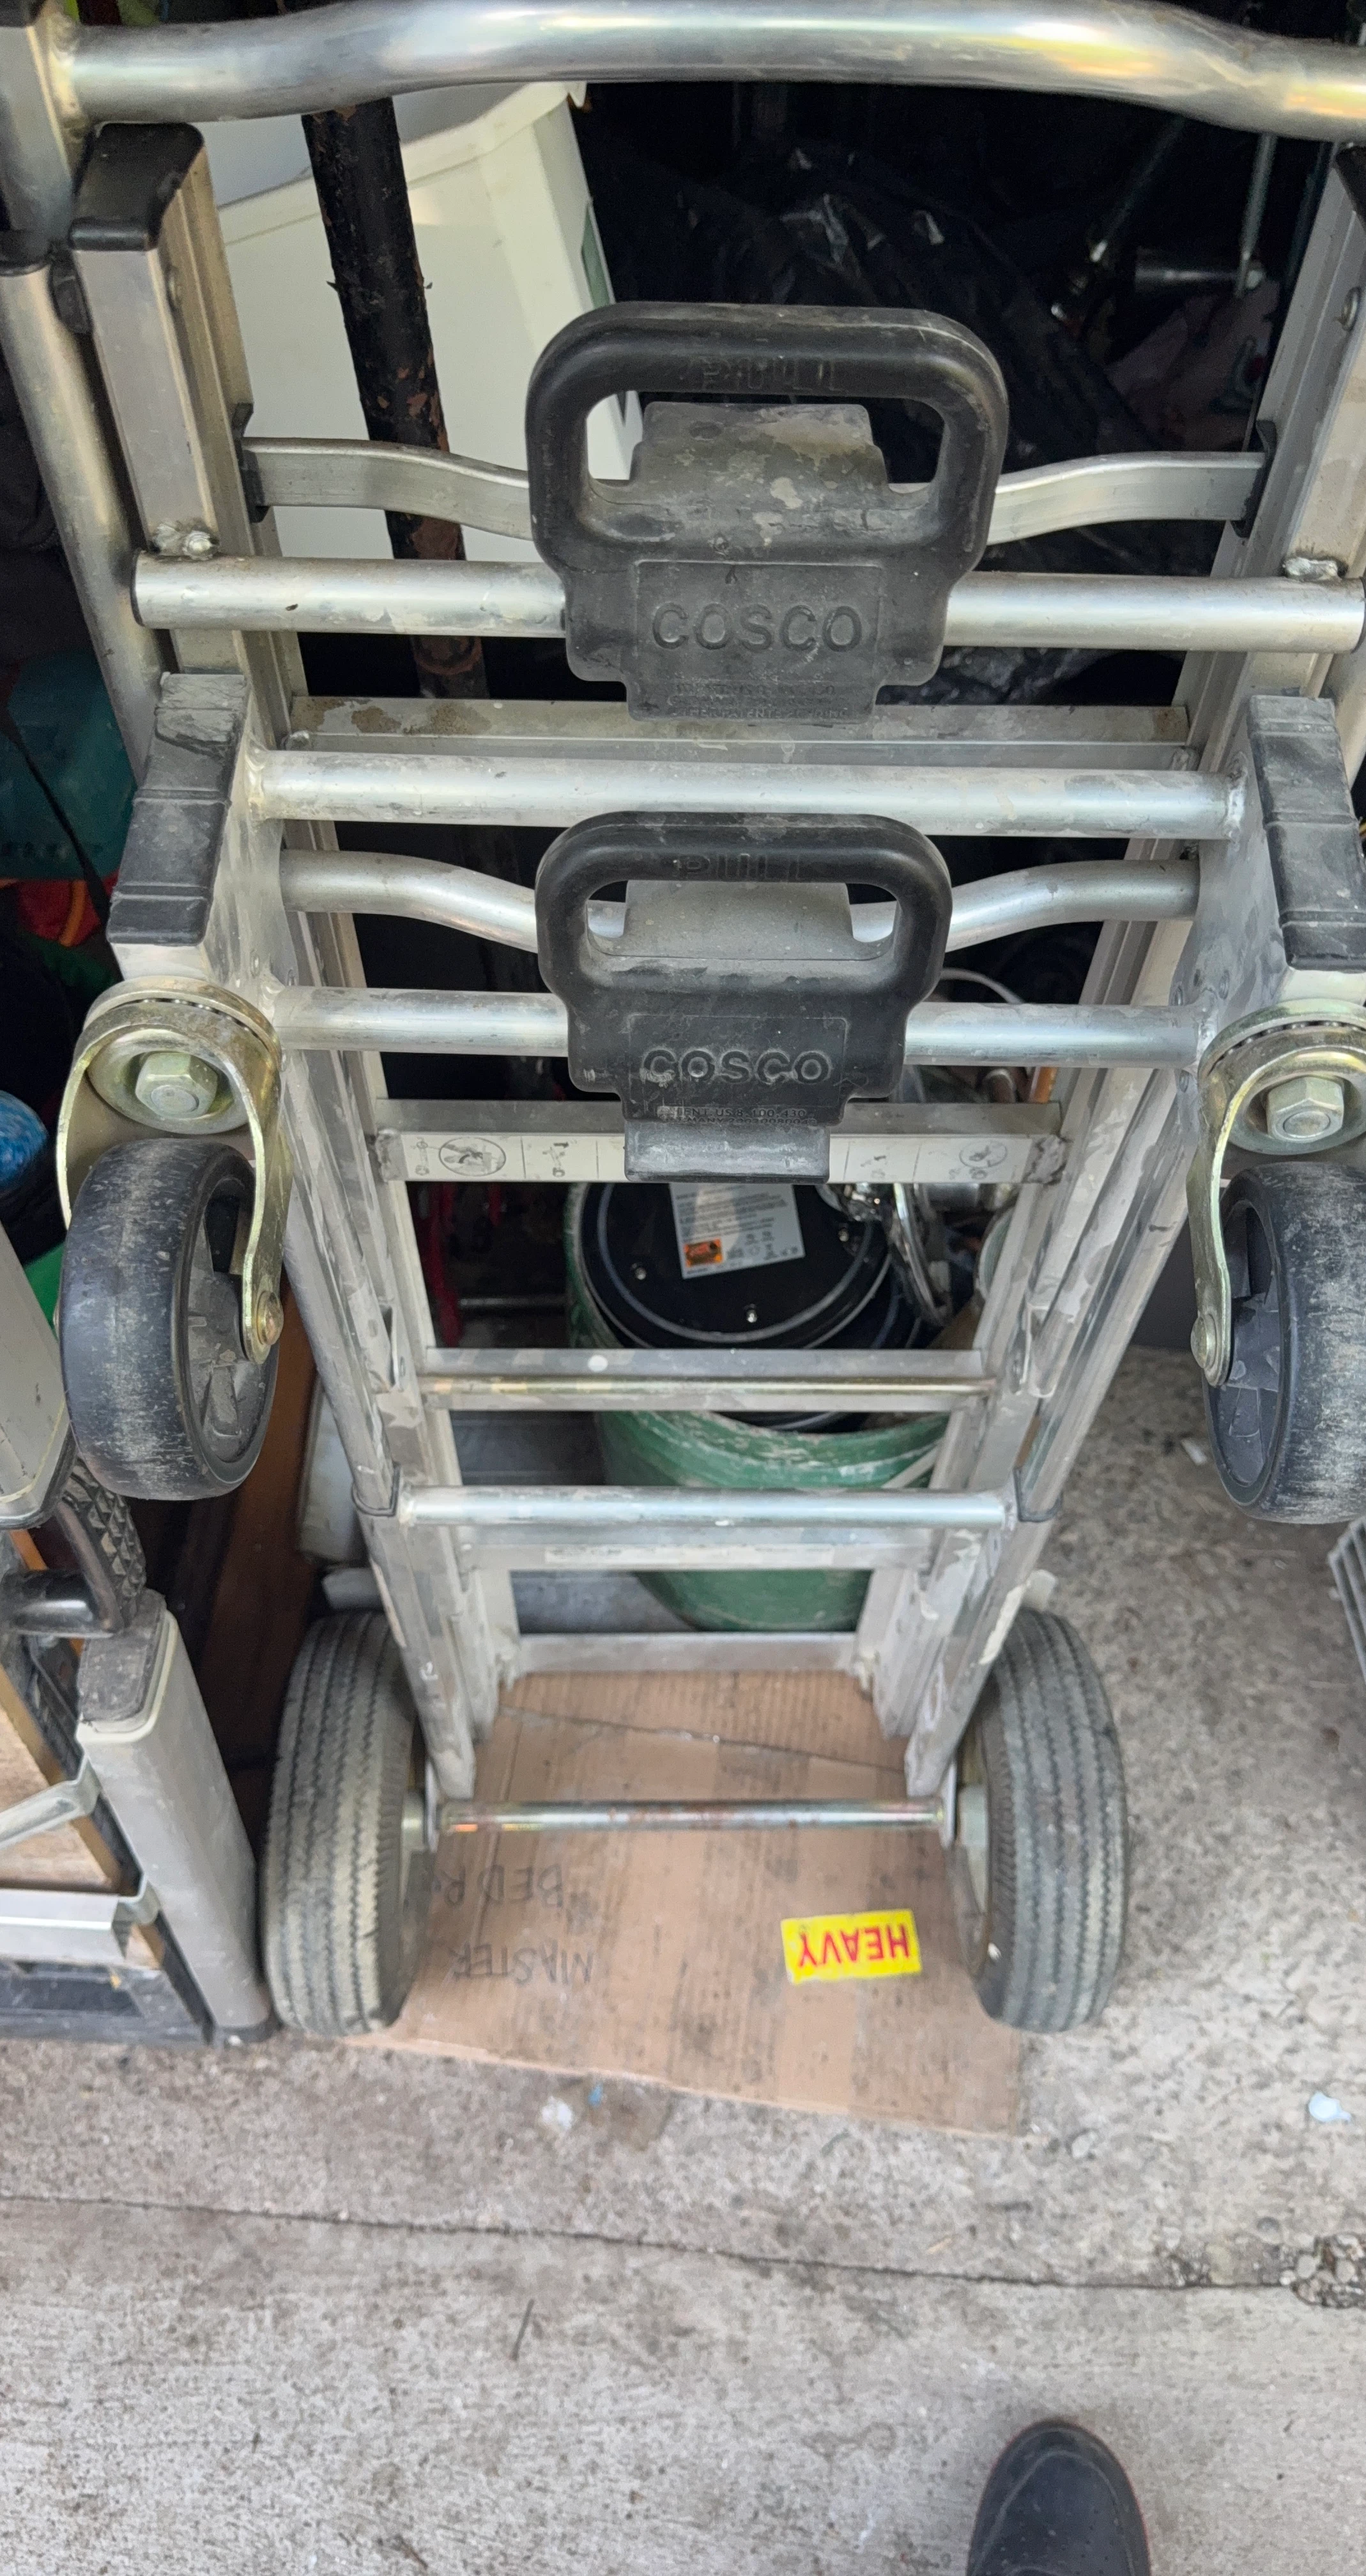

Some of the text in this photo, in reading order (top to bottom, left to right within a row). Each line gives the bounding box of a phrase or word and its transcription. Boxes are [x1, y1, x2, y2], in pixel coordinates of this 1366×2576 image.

[652, 601, 862, 652] COSCO
[640, 1048, 831, 1085] COSCO
[447, 1939, 594, 1984] MASTER
[799, 1923, 910, 1968] HEAVY
